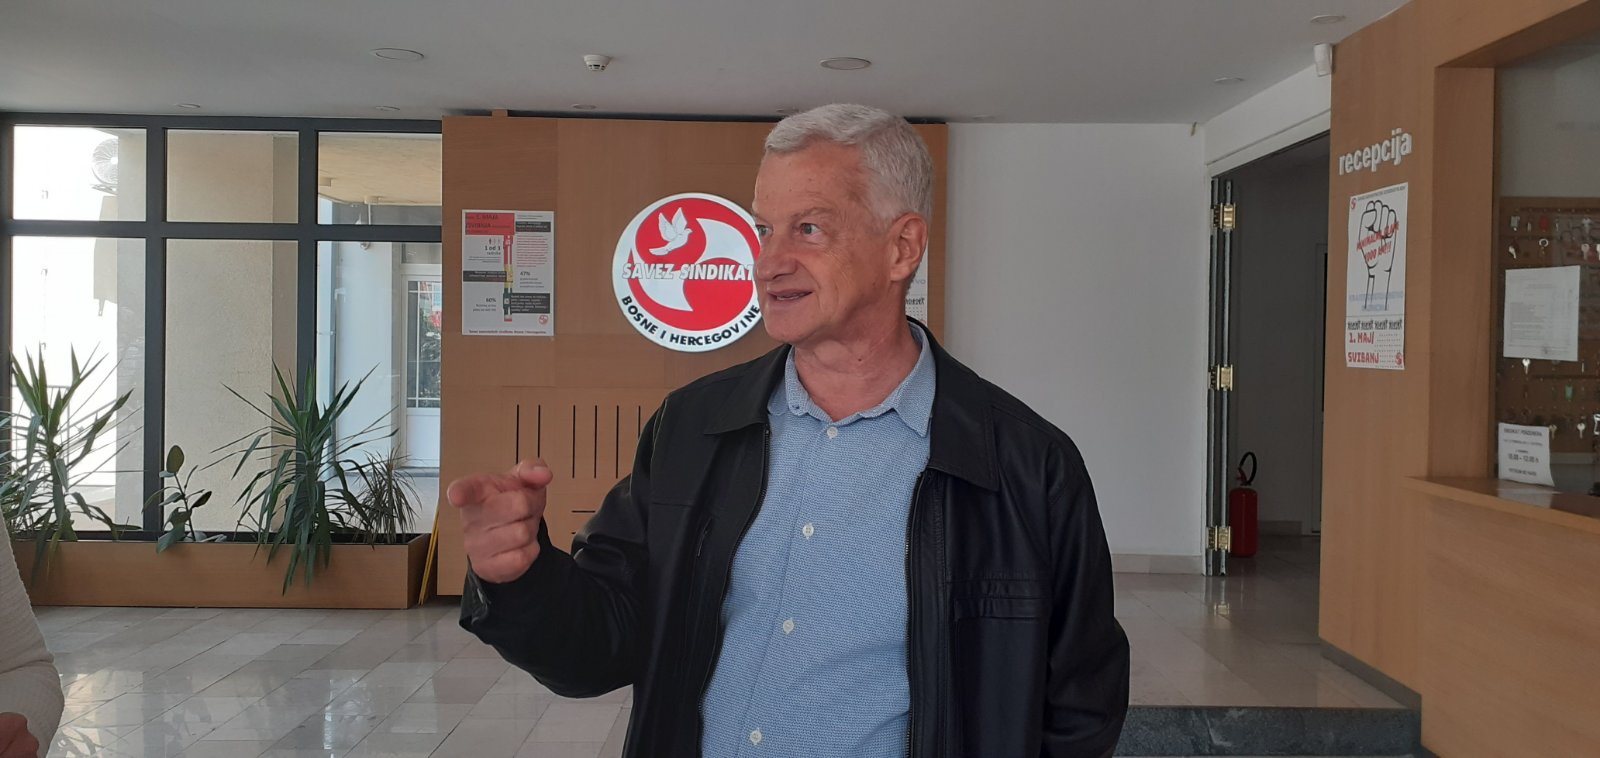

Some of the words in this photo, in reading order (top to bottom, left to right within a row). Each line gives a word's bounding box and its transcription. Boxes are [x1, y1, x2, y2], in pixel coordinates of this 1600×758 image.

[1339, 128, 1412, 175] recepcija
[622, 263, 675, 280] SAVEZ
[679, 263, 754, 281] SINDIKAT
[621, 295, 658, 334] BOSNE
[659, 330, 667, 340] I
[669, 304, 761, 346] HERCEGOVINE
[1349, 332, 1356, 343] 1.
[1347, 351, 1380, 364] SVIBANJ
